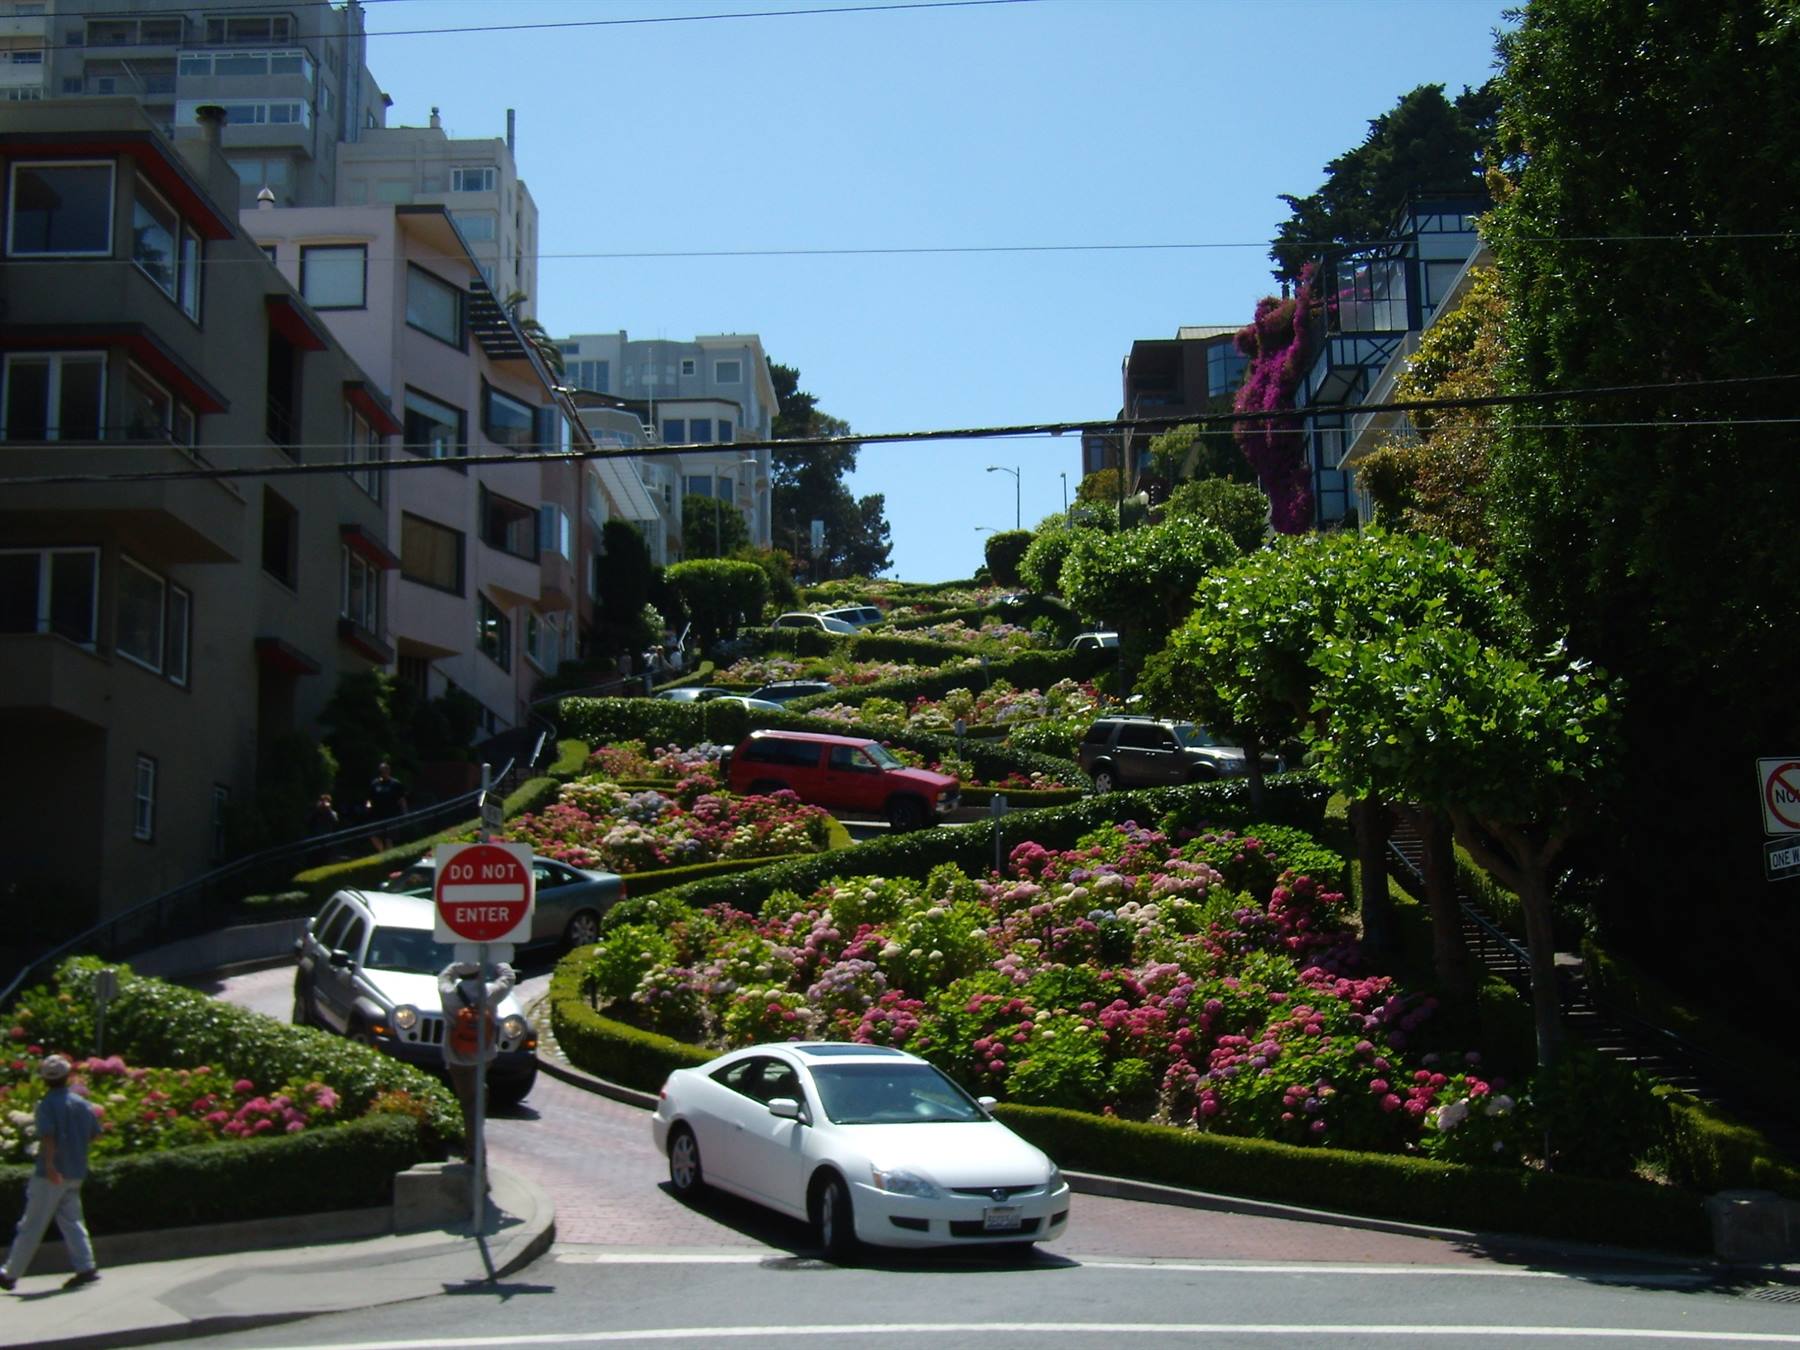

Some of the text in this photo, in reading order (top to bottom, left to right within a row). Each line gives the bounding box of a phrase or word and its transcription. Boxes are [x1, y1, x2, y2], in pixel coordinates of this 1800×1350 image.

[1772, 847, 1800, 868] ONE W
[450, 863, 517, 880] DO NOT
[456, 907, 510, 923] ENTER
